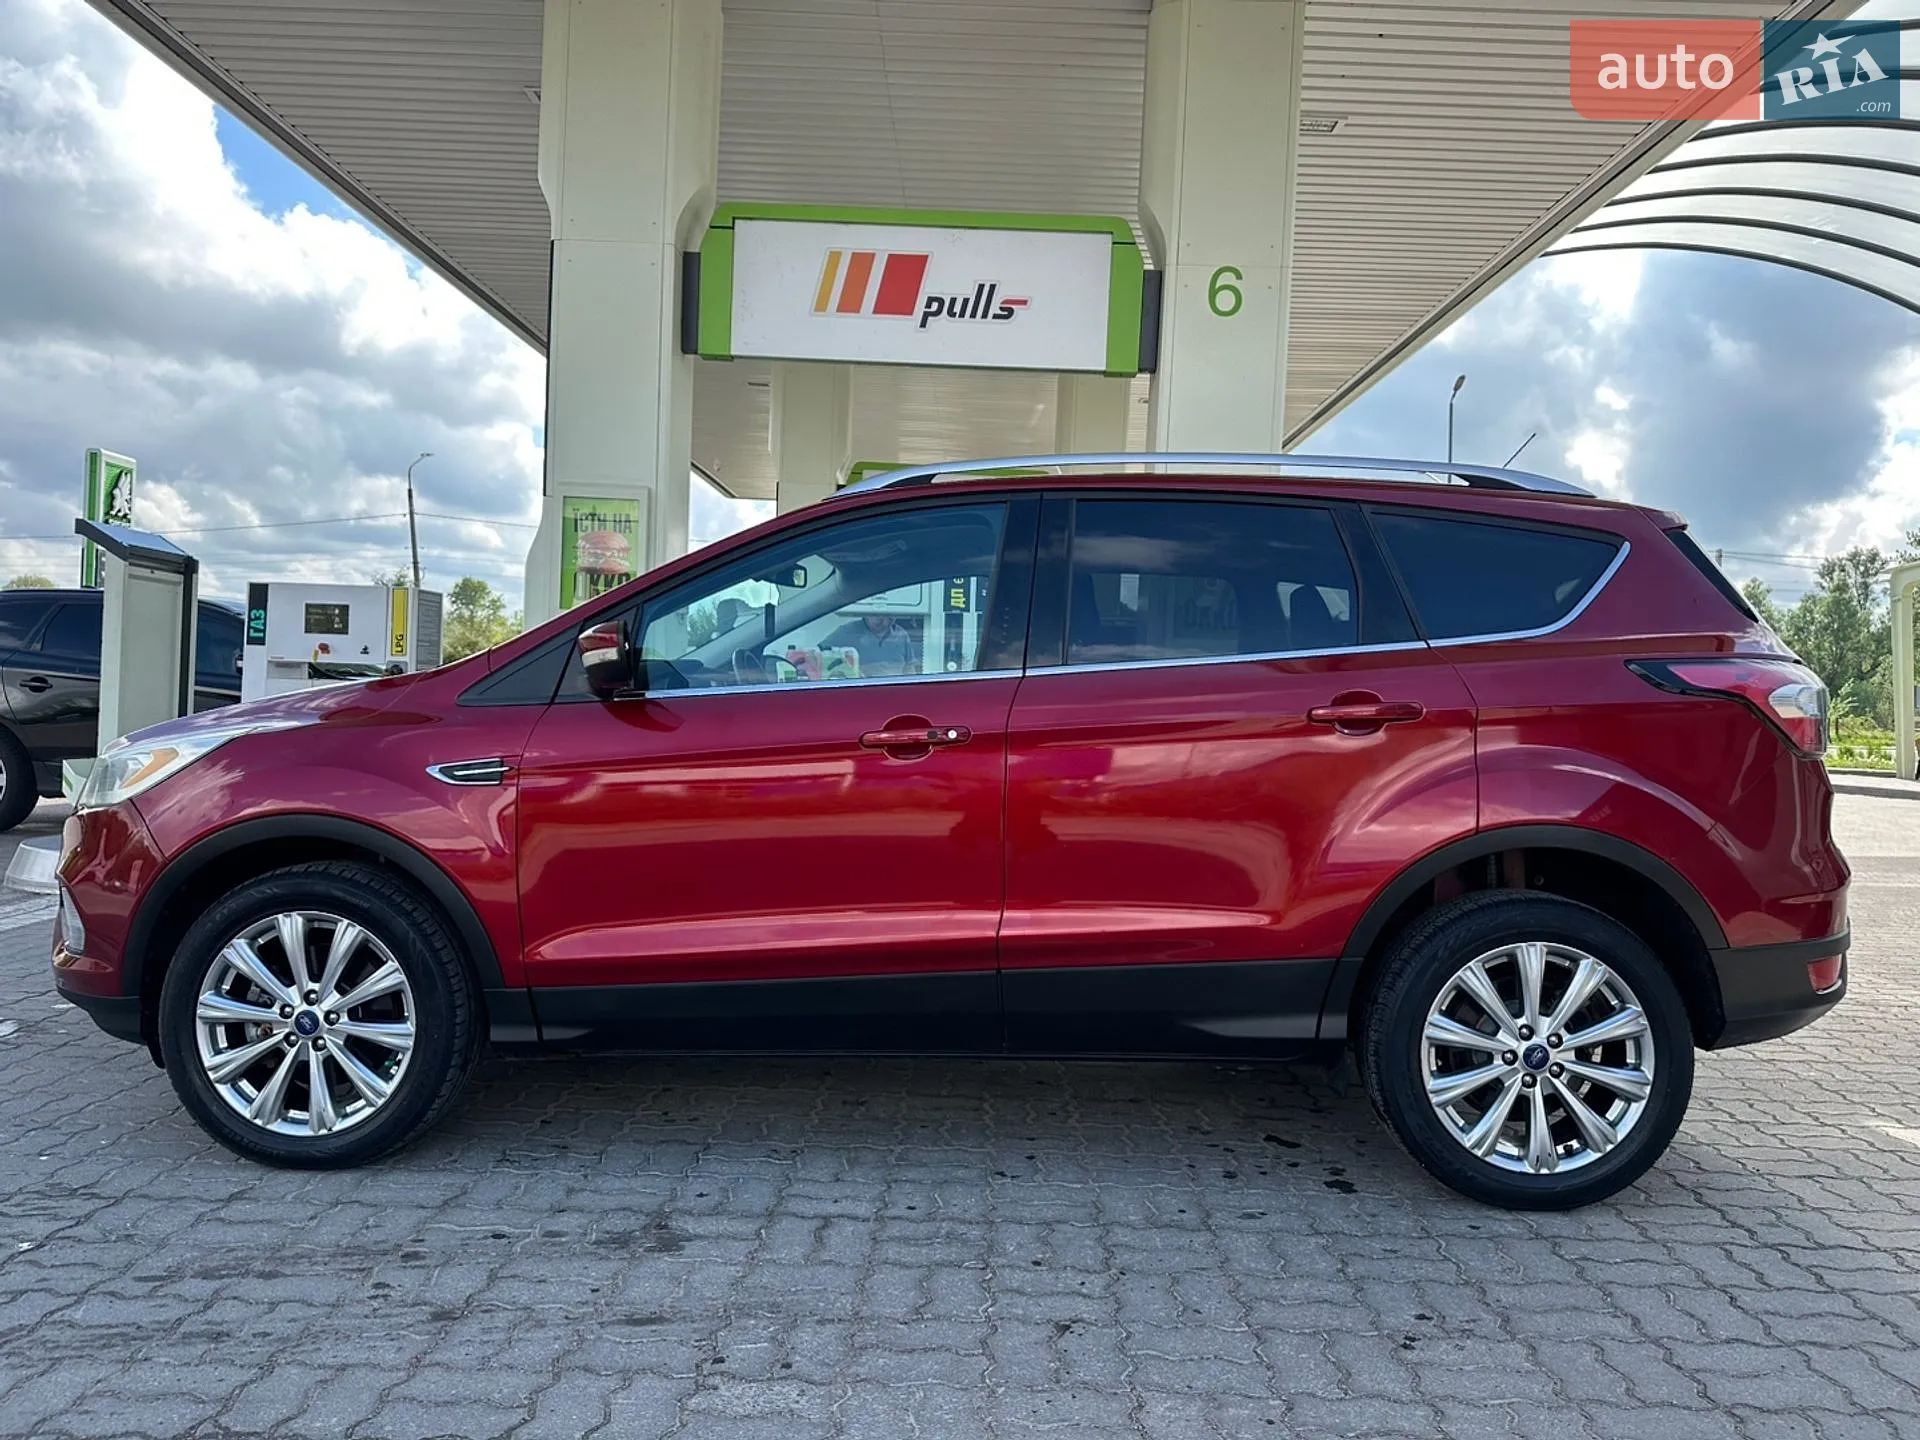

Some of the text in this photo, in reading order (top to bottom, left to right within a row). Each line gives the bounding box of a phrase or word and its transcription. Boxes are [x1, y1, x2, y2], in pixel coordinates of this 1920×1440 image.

[918, 283, 1029, 329] pulls
[1207, 265, 1244, 317] 6
[249, 608, 265, 638] ГАЗ
[394, 633, 404, 654] LPG
